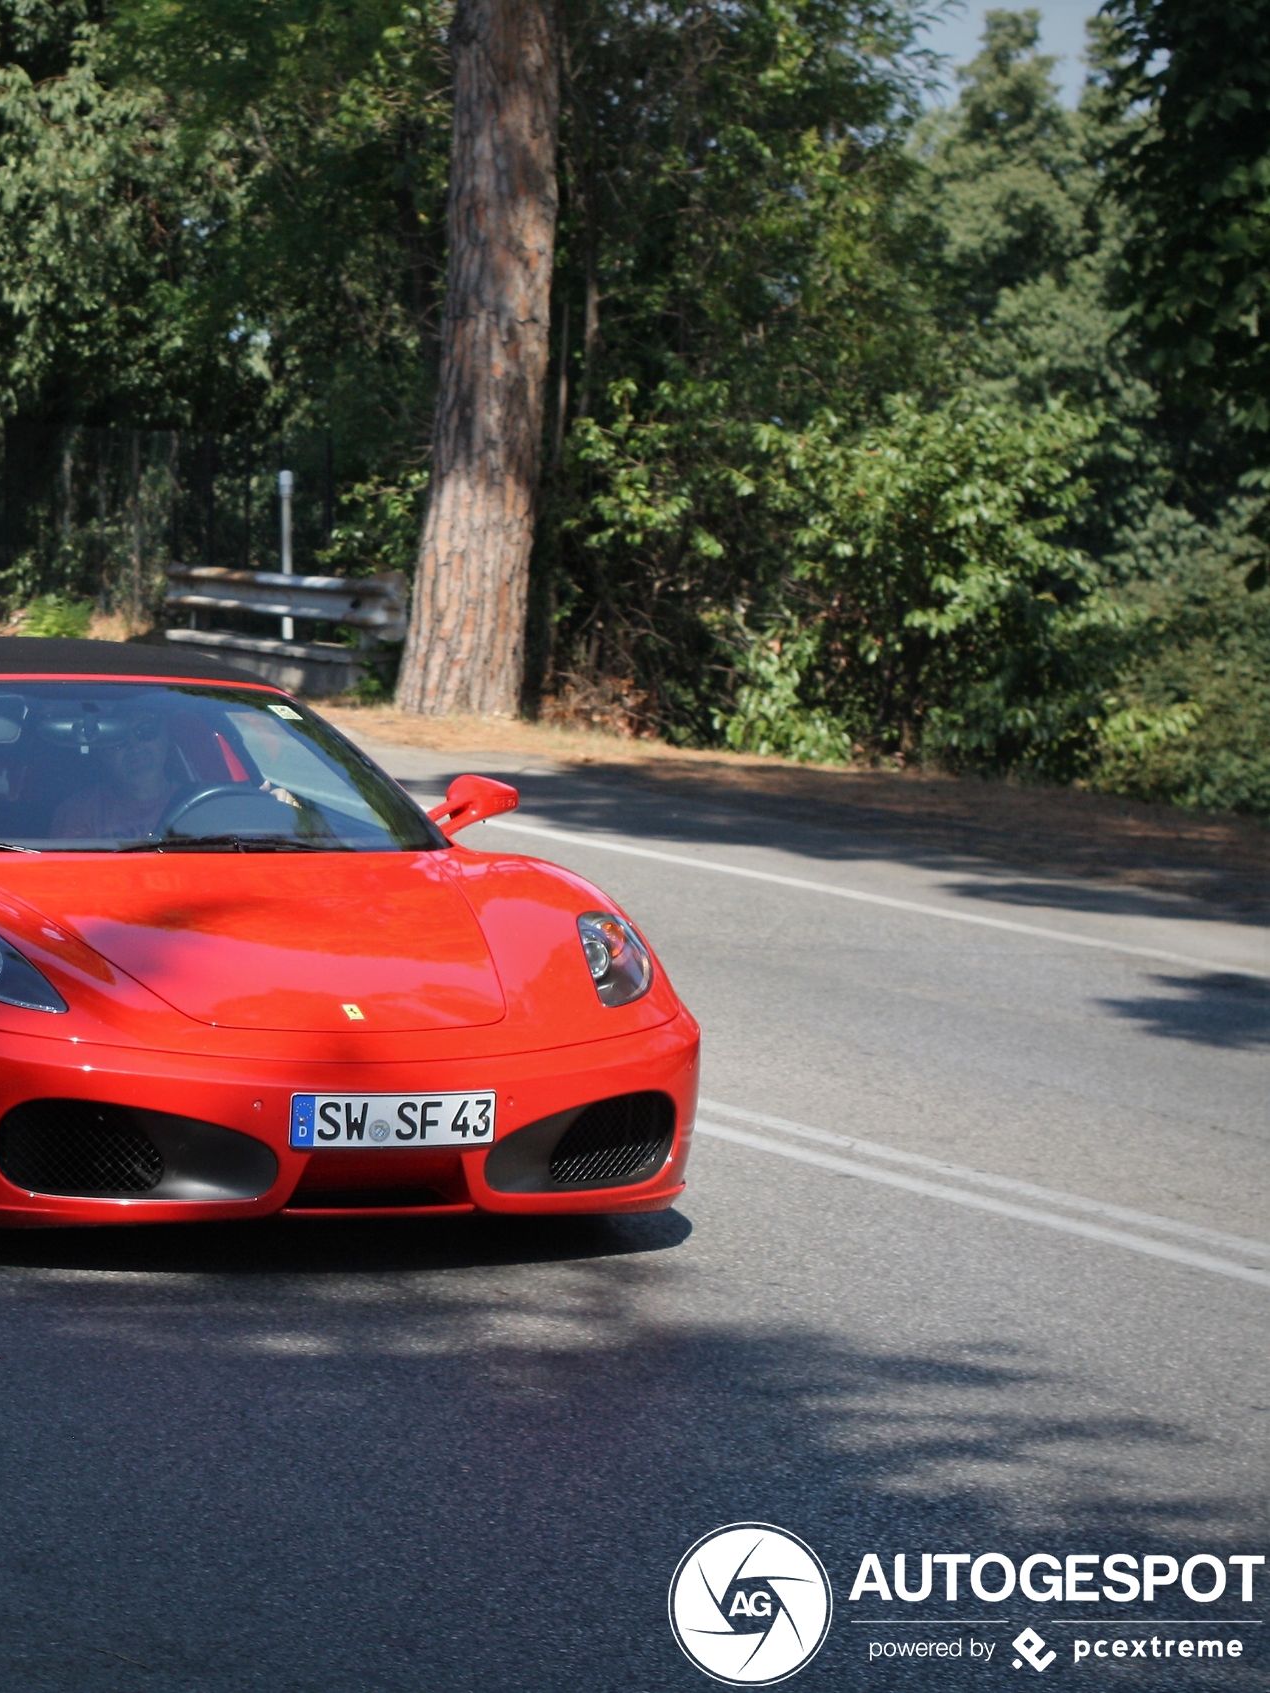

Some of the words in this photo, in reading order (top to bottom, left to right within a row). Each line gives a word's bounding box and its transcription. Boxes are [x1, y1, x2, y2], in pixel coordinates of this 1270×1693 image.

[298, 1125, 308, 1138] D
[317, 1101, 369, 1141] SW
[395, 1101, 443, 1140] SF
[451, 1099, 492, 1138] 43
